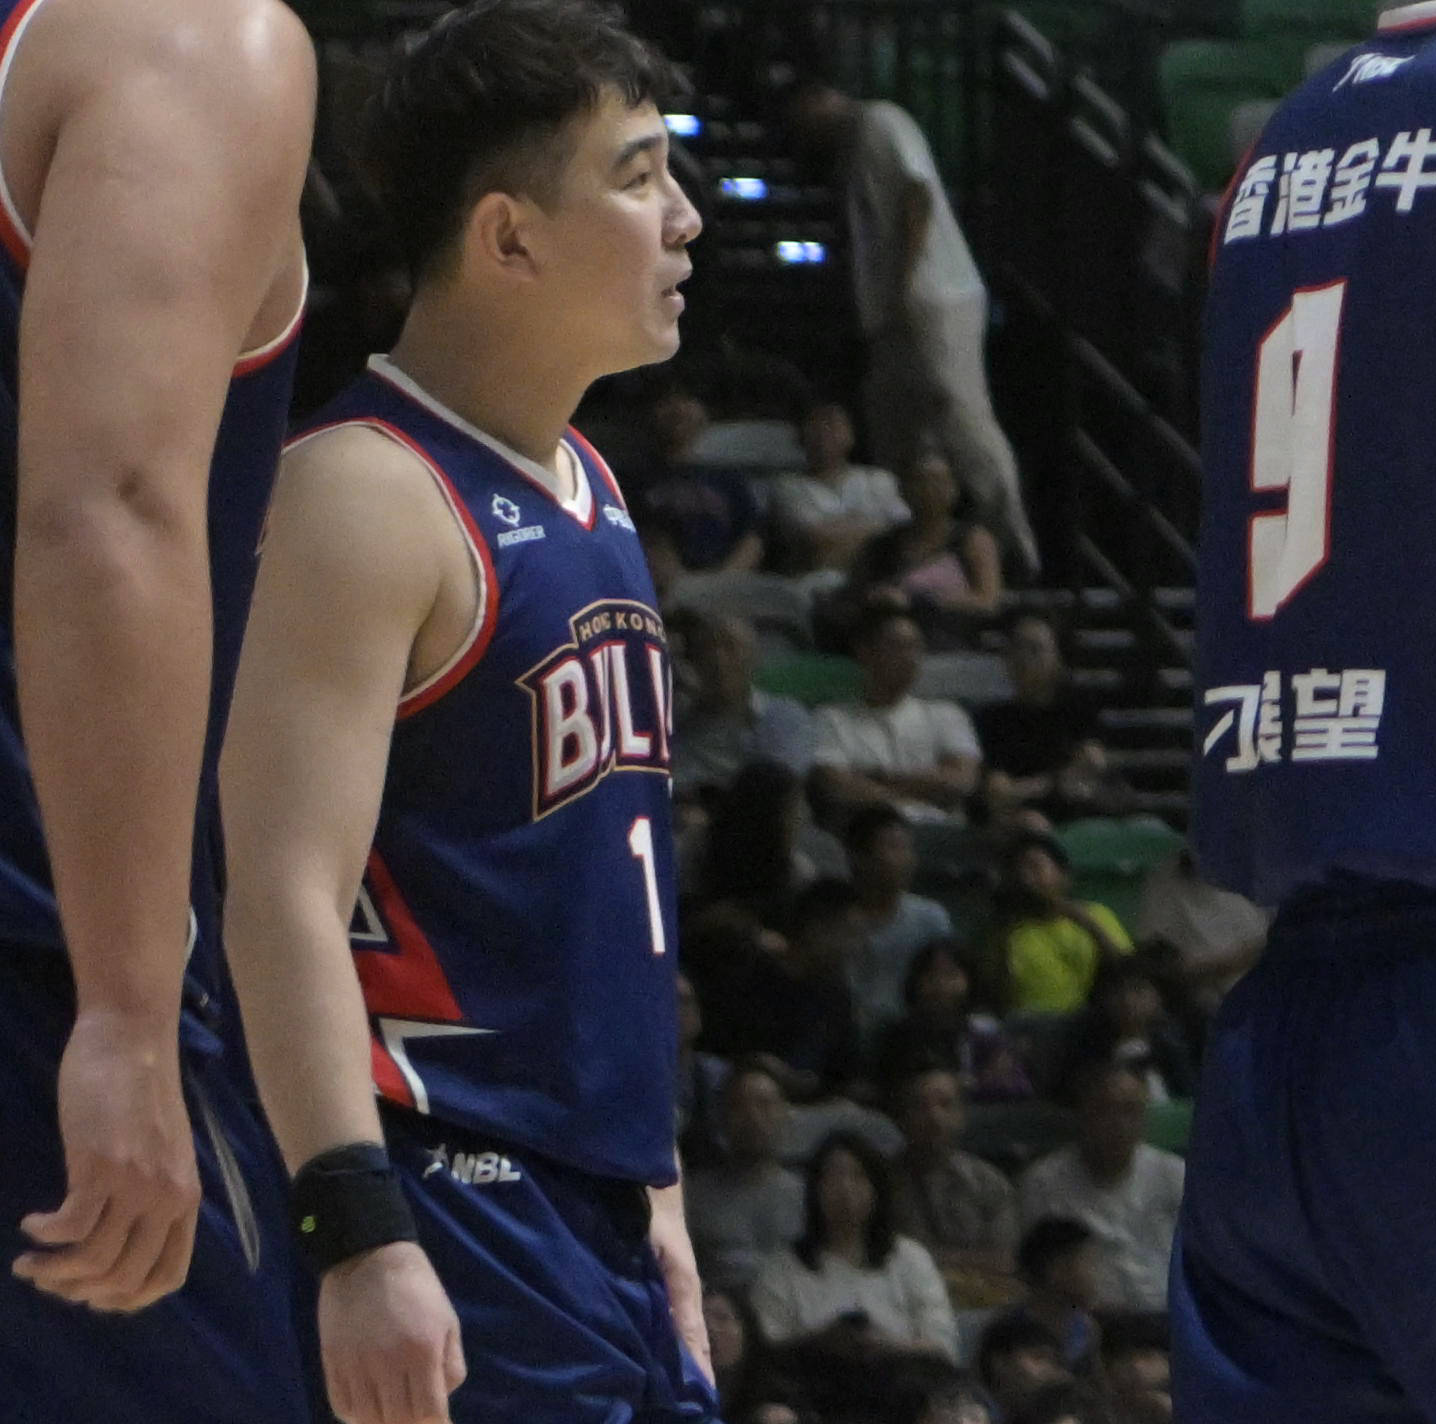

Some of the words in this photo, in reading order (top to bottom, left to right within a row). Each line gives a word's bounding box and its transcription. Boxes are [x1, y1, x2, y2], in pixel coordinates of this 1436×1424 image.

[1249, 279, 1347, 620] 9
[580, 612, 611, 642] HOG
[540, 640, 672, 803] BULL
[627, 816, 665, 955] 1
[452, 1152, 521, 1185] NBL
